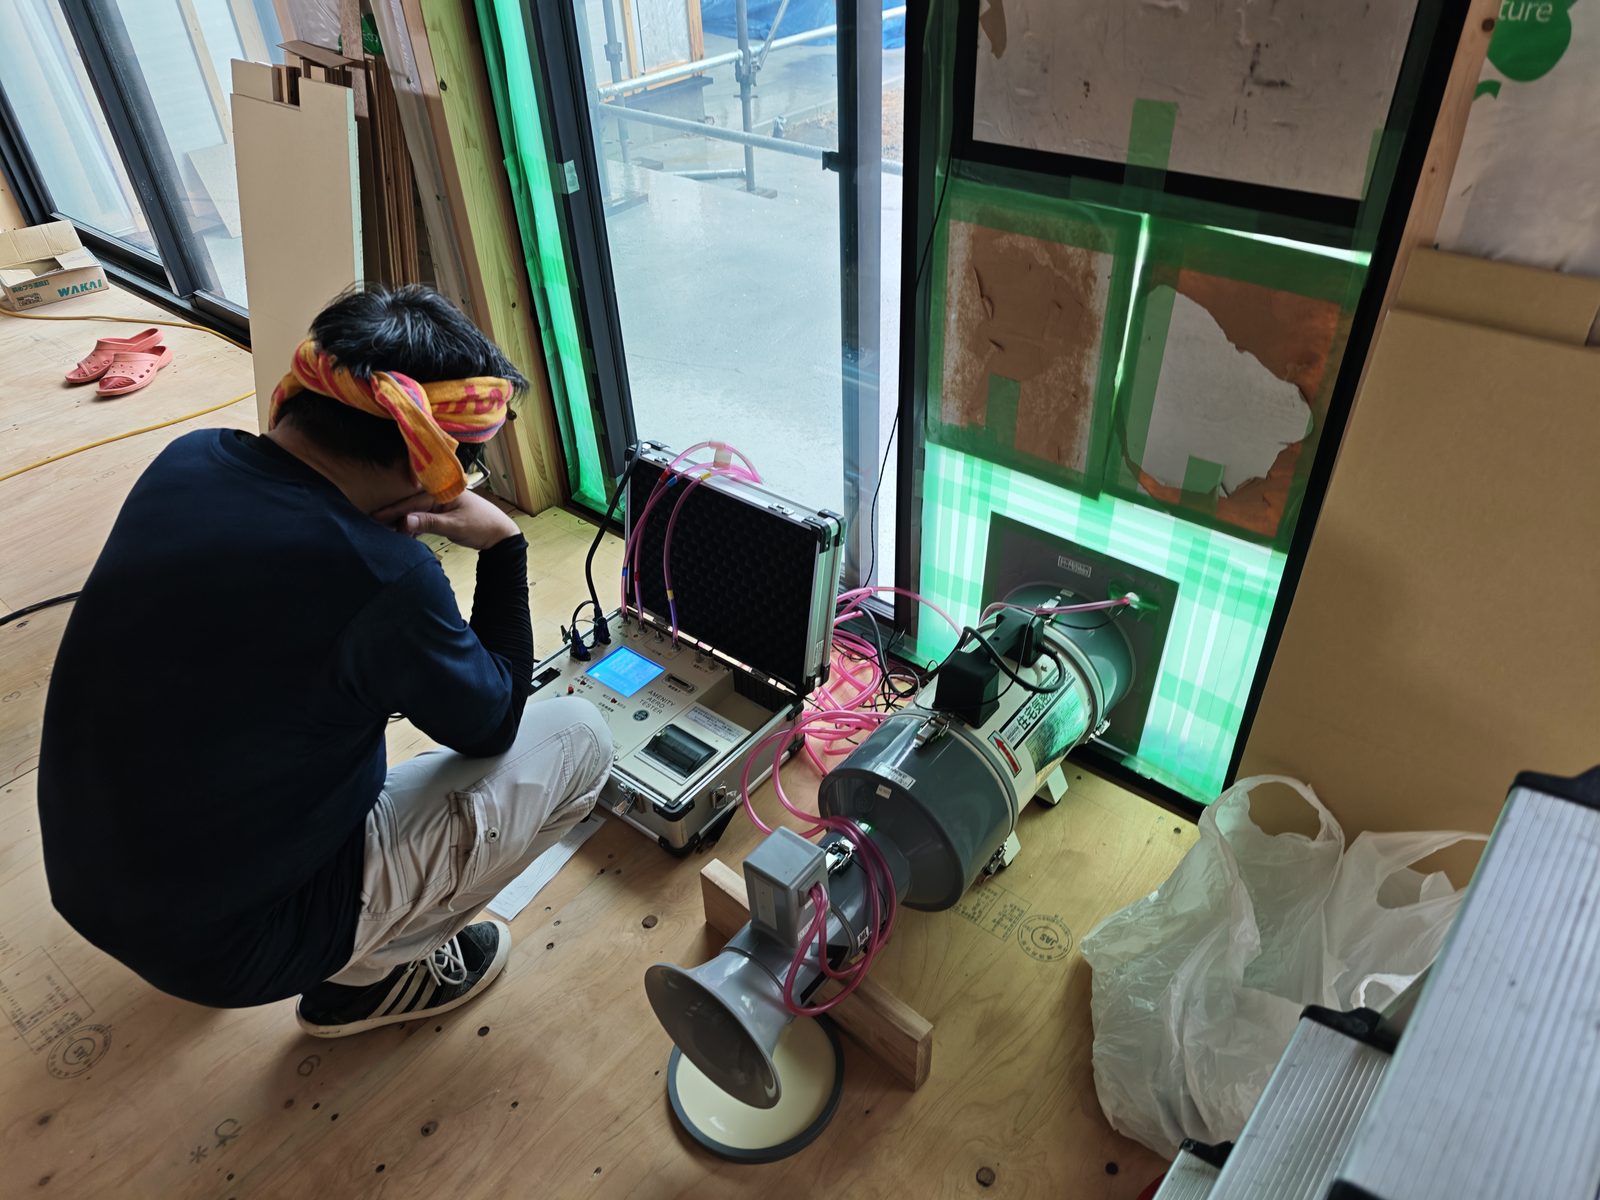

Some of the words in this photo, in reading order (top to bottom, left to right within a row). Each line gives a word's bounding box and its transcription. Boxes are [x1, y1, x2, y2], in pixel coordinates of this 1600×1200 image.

[57, 279, 103, 297] WAKAI
[646, 697, 665, 709] AERO
[648, 690, 675, 706] AMENITY
[639, 699, 663, 714] TESTER
